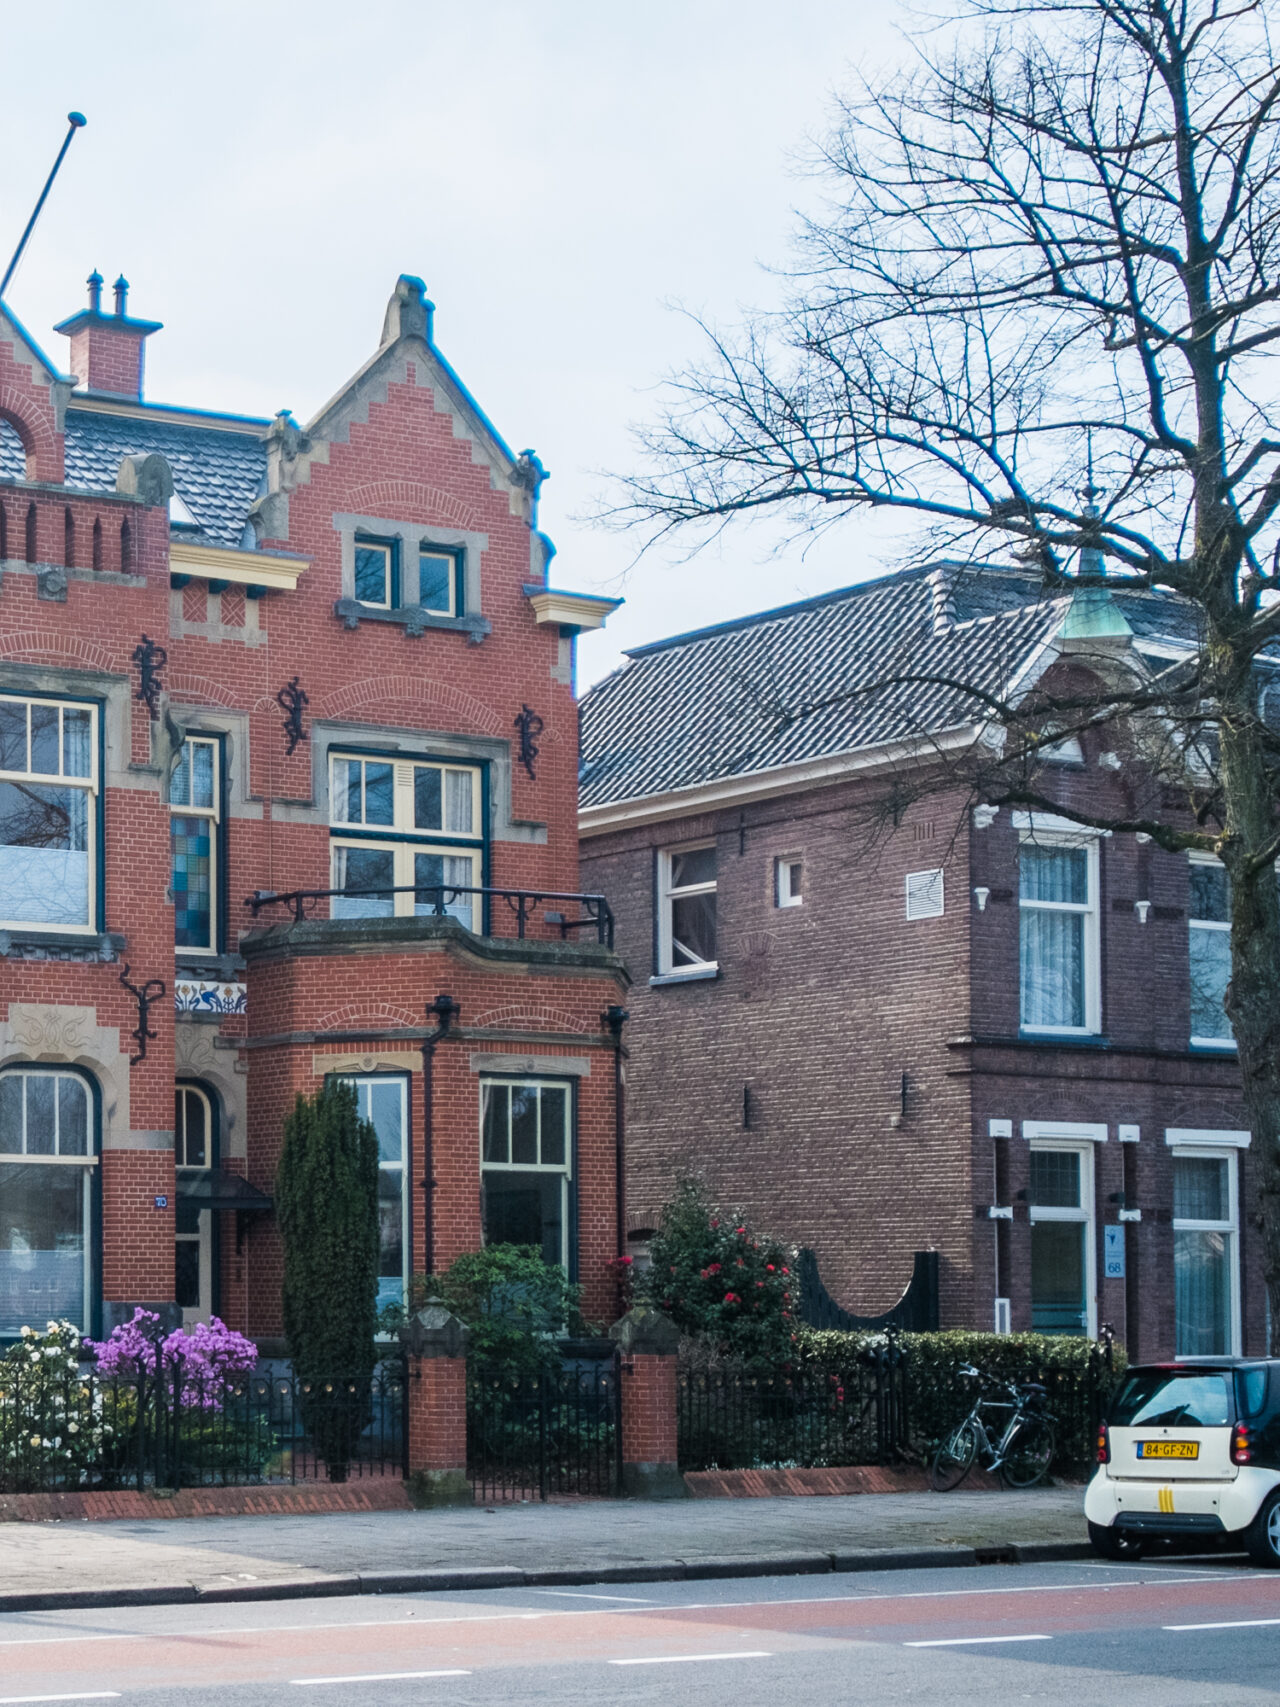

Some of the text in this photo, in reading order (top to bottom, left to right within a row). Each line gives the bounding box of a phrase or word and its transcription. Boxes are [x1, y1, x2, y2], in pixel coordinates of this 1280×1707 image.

[155, 1197, 167, 1207] 70
[1108, 1262, 1121, 1273] 68
[1146, 1444, 1194, 1456] 84-GF-ZN
